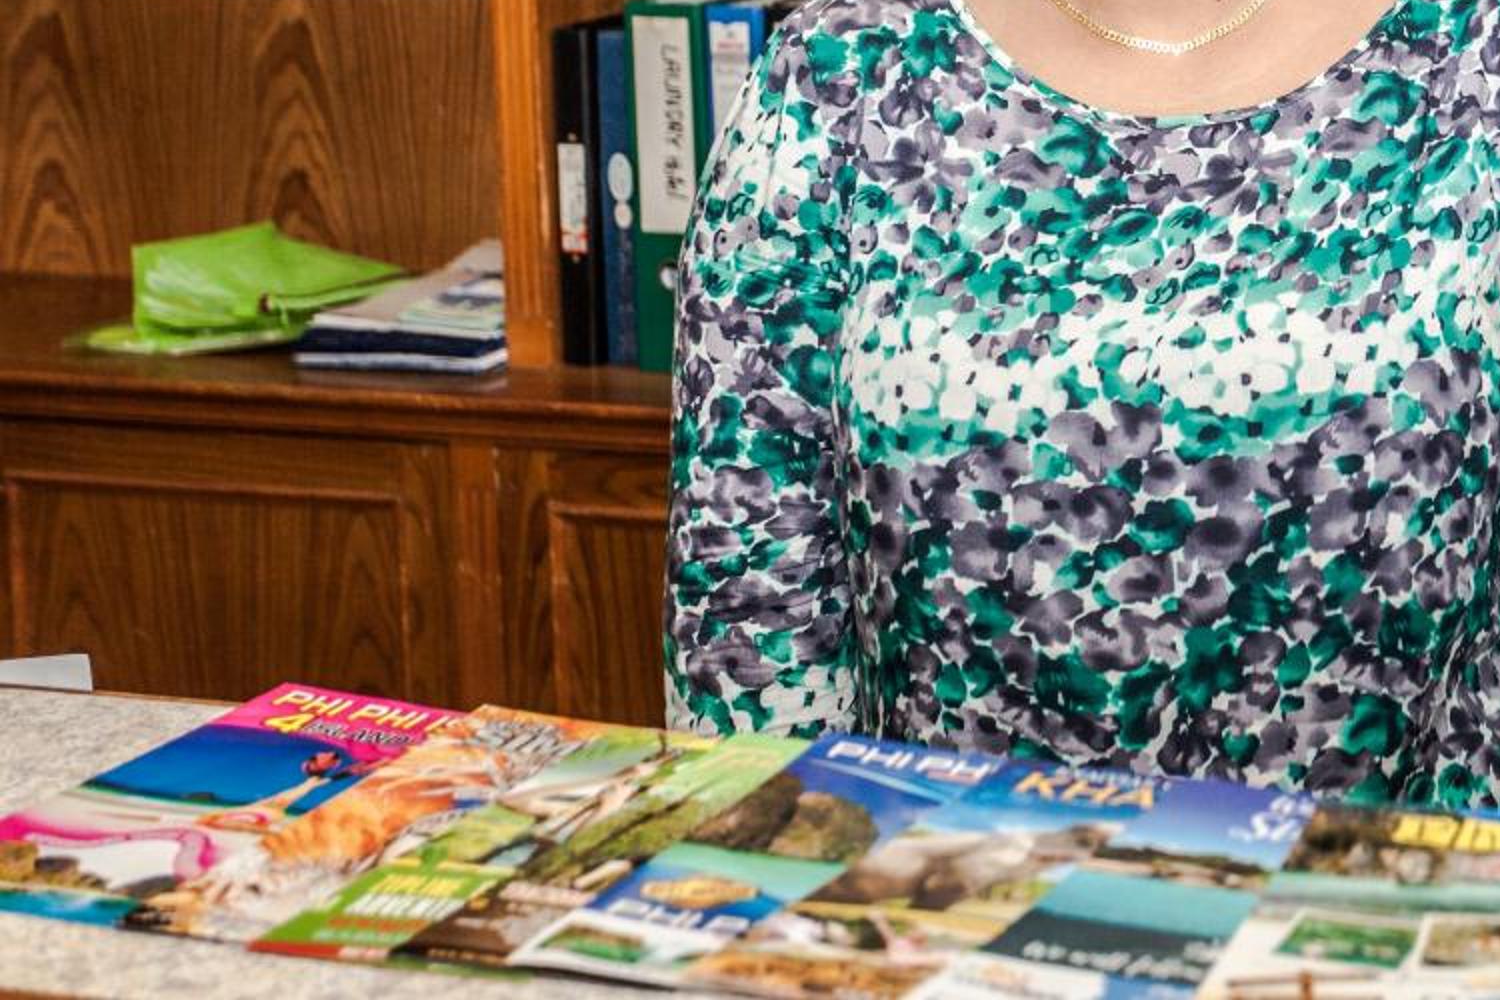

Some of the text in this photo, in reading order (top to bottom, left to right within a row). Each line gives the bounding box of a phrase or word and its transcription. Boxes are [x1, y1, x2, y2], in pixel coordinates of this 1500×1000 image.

[264, 712, 315, 735] 4
[272, 688, 353, 717] PHI
[350, 703, 431, 732] PHI
[827, 740, 914, 770] PHI
